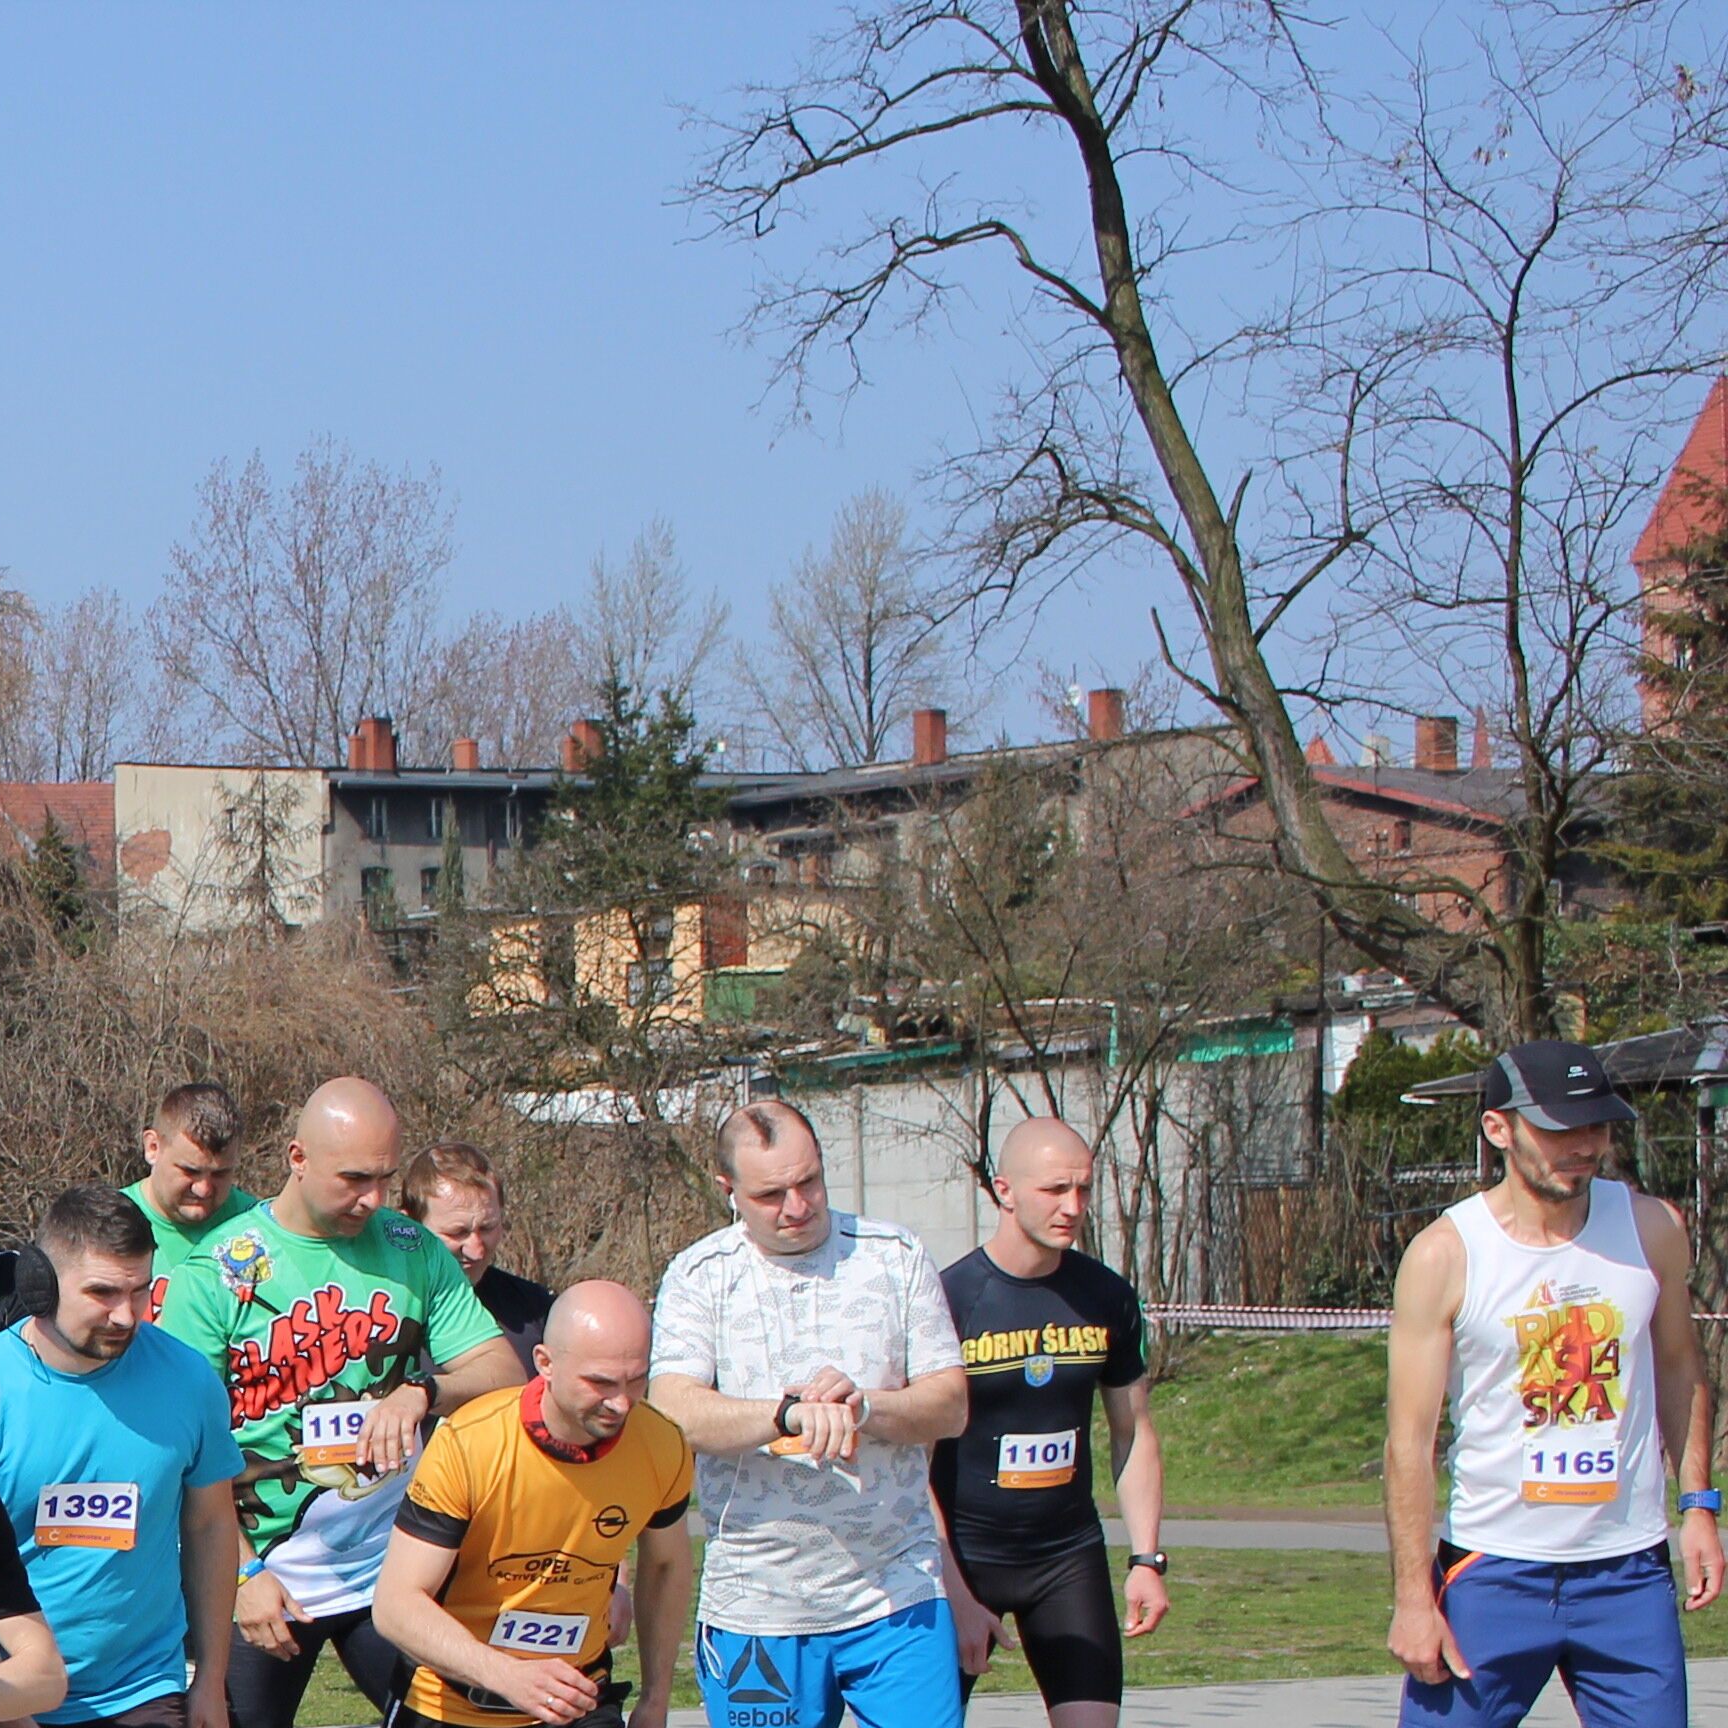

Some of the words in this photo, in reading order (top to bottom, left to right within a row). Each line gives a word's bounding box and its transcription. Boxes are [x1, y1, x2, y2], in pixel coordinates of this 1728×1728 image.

[962, 1330, 1039, 1364] GÓRNY
[1042, 1322, 1109, 1356] ŚLĄSK
[1006, 1441, 1071, 1464] 1101
[1530, 1451, 1614, 1475] 1165
[44, 1494, 132, 1519] 1392
[524, 1557, 573, 1575] OPEL
[501, 1619, 580, 1647] 1221
